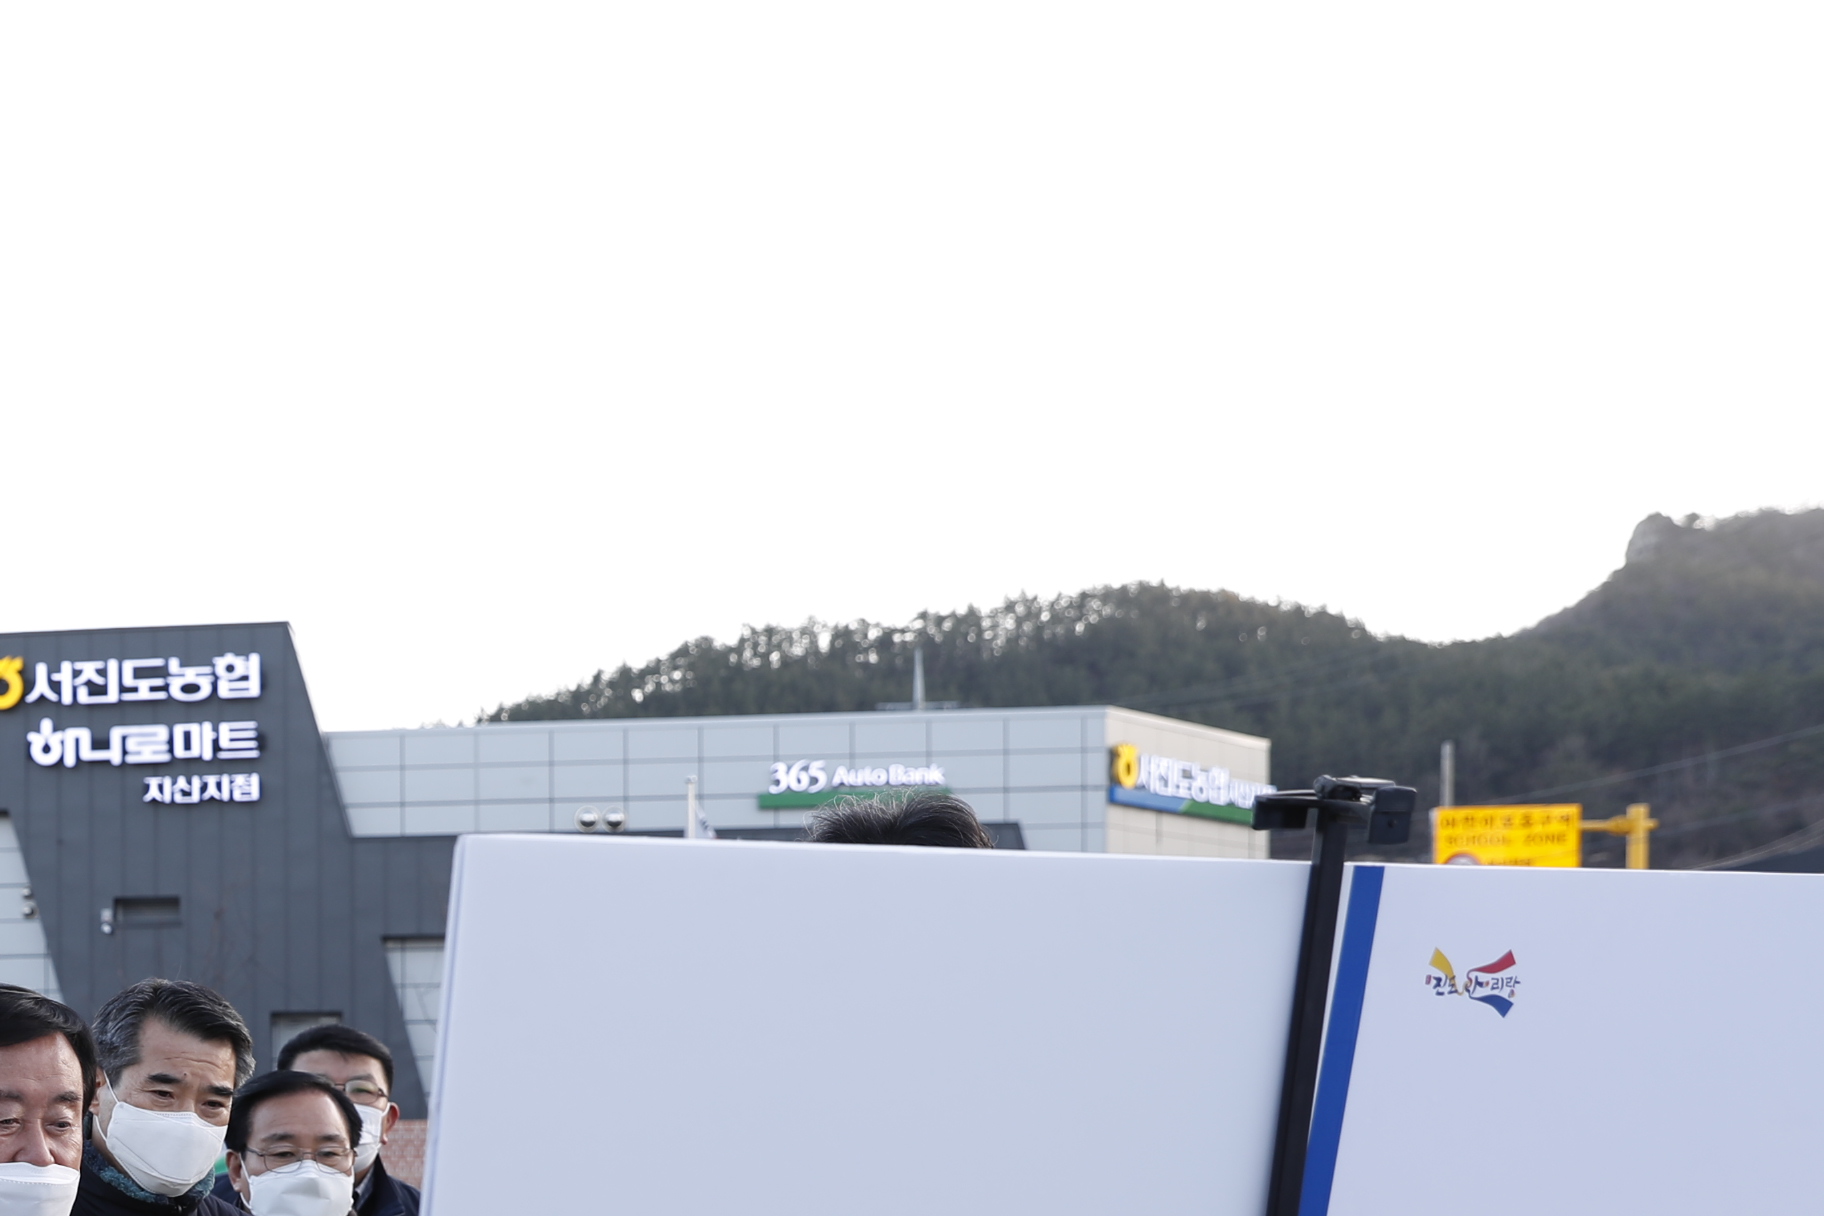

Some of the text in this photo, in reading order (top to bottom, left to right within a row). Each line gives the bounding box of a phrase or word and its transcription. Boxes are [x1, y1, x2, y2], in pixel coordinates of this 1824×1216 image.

[24, 652, 262, 706] 서진도농협
[26, 716, 262, 768] 하나로마트
[142, 772, 260, 804] 지산지점
[768, 759, 945, 794] 365 Auto Bank
